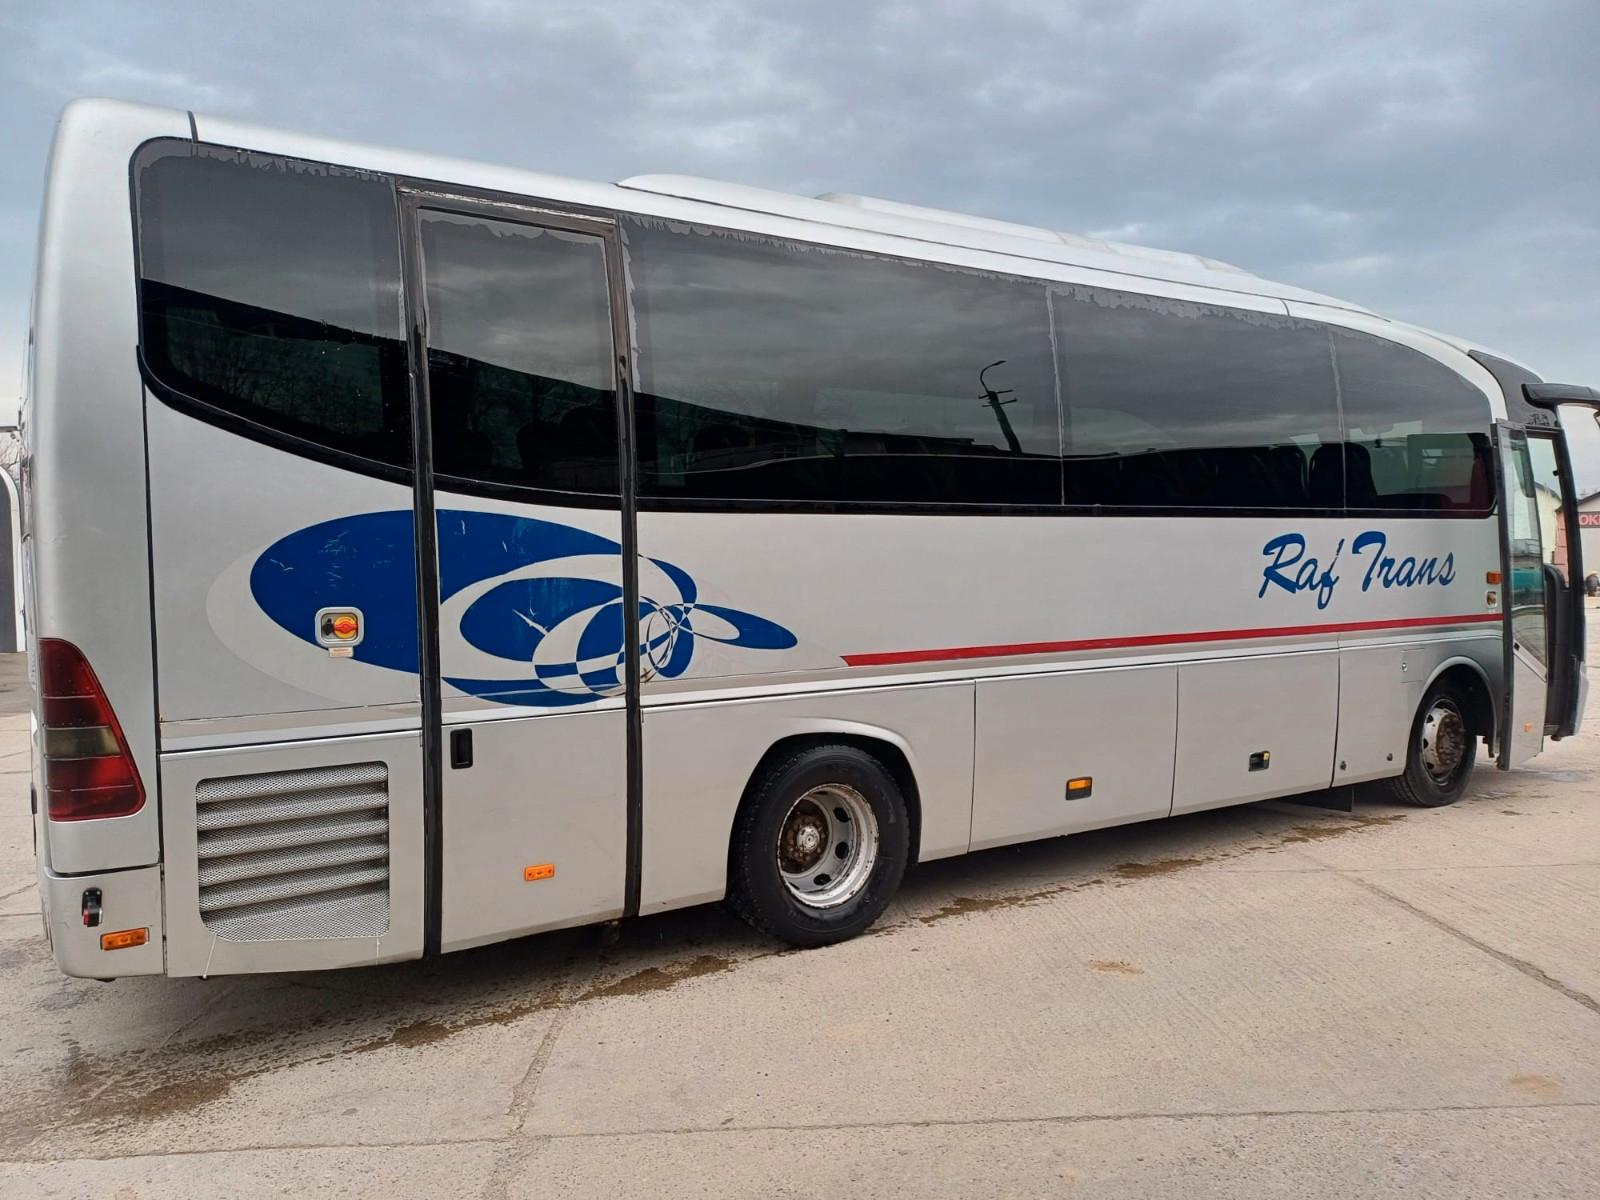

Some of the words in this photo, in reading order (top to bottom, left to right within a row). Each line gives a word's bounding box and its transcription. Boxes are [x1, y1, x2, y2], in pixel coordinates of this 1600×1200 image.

[1579, 514, 1600, 526] OK
[1258, 533, 1345, 609] Raf
[1352, 531, 1456, 592] Trans
